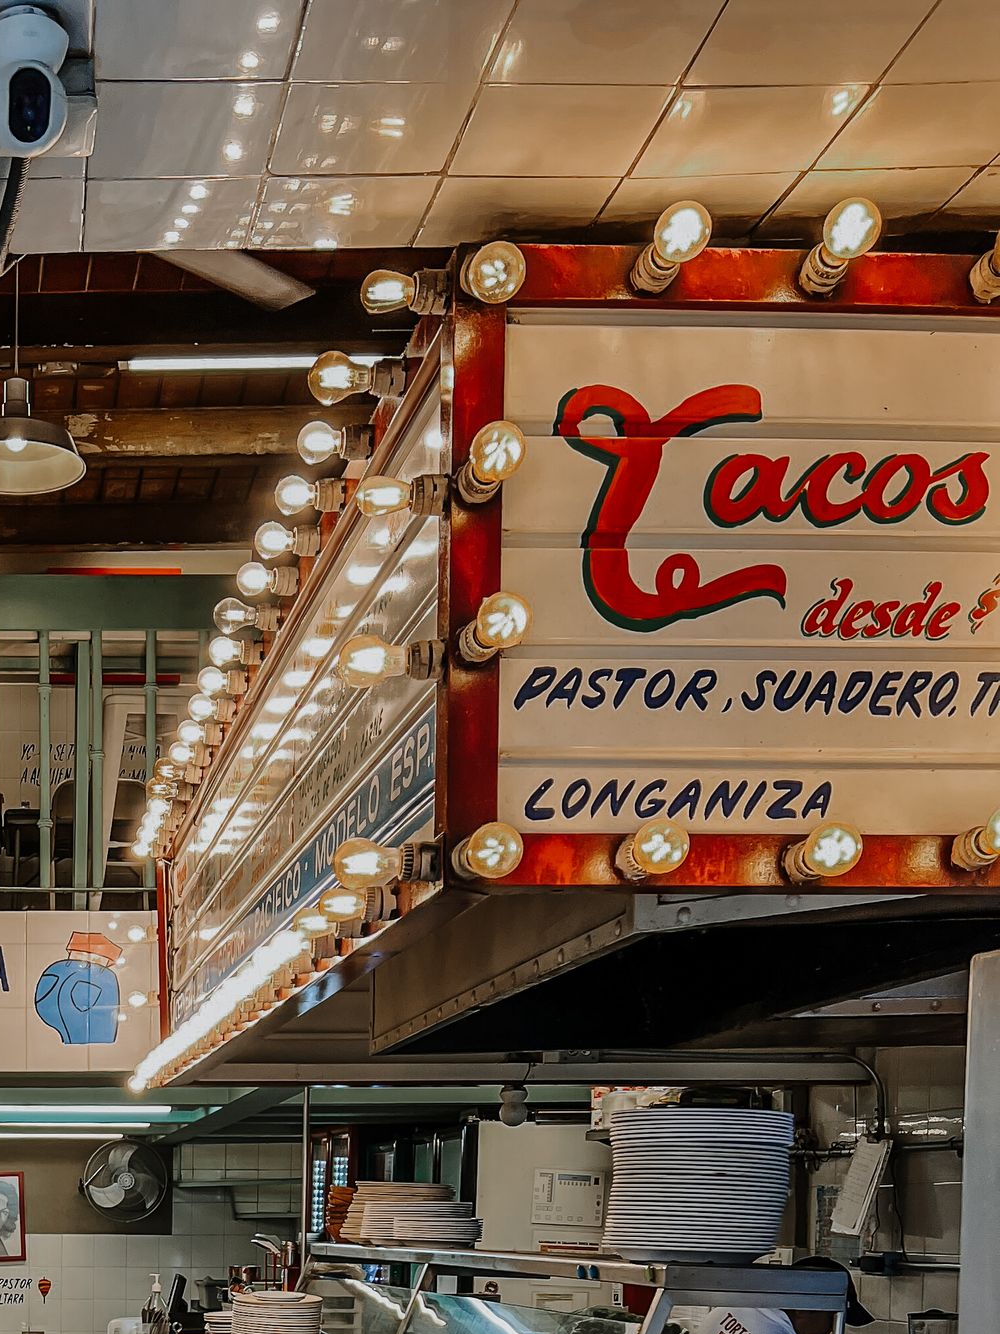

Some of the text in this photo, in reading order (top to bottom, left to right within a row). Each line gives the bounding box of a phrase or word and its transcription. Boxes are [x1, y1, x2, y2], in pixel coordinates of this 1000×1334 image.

[553, 384, 990, 632] Tacos
[801, 577, 961, 641] desde
[523, 776, 834, 822] LONGANIZA
[254, 861, 301, 941] PACIFICO
